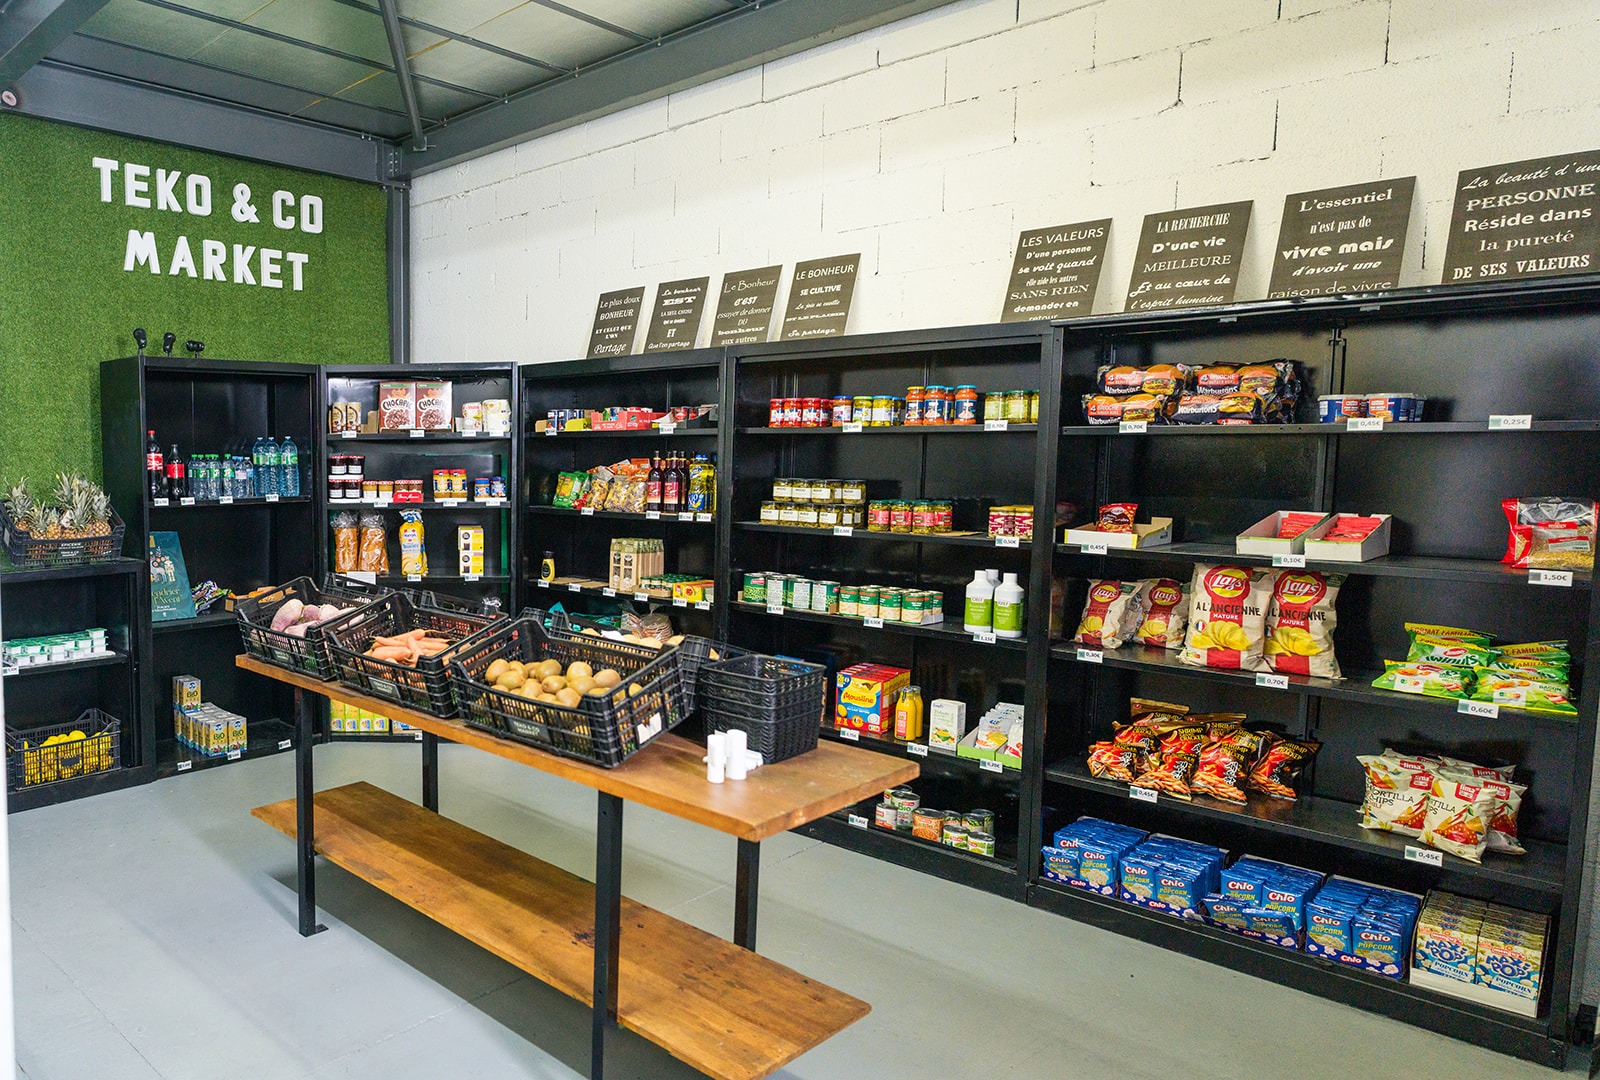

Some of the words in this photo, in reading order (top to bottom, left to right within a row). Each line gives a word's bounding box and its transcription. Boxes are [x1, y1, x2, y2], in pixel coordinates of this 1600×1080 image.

[1462, 177, 1488, 190] La
[1495, 167, 1551, 185] beauté
[93, 157, 212, 216] TEKO
[231, 183, 259, 222] &
[272, 190, 322, 233] CO
[1299, 188, 1393, 212] L'essentiel
[1466, 183, 1596, 211] PERSONNE
[1157, 222, 1169, 233] LA
[1171, 213, 1230, 231] RECHERCHE
[1310, 220, 1335, 234] n'est
[1337, 220, 1356, 233] pas
[1359, 216, 1372, 228] de
[1464, 213, 1534, 232] Réside
[1540, 208, 1592, 222] dans
[1022, 237, 1042, 247] LES
[1046, 228, 1103, 243] VALEURS
[1152, 241, 1199, 253] D'une
[1204, 236, 1226, 247] vie
[1479, 239, 1499, 251] la
[1505, 230, 1574, 251] pureté
[1052, 246, 1091, 257] personne
[1282, 245, 1332, 260] vivre
[1339, 236, 1394, 254] mais
[124, 229, 308, 290] MARKET
[1033, 263, 1054, 272] voit
[1057, 255, 1097, 273] quand
[1143, 255, 1231, 273] MEILLEURE
[796, 271, 806, 280] LE
[808, 264, 854, 278] BONHEUR
[1292, 263, 1349, 277] d'avoir
[1353, 261, 1382, 270] une
[1453, 267, 1472, 279] DE
[1480, 262, 1507, 277] SES
[1516, 255, 1590, 272] VALEURS
[724, 283, 736, 293] Le
[738, 278, 775, 291] Bonheur
[810, 285, 842, 294] CULTIVE
[1011, 289, 1048, 300] SANS
[1051, 284, 1089, 296] RIEN
[1129, 282, 1152, 297] Et
[1176, 279, 1210, 288] cœur
[1214, 274, 1230, 284] de
[1270, 286, 1320, 299] raison
[1326, 281, 1347, 293] de
[1352, 281, 1392, 291] vivre
[609, 298, 622, 308] plus
[1014, 302, 1064, 313] demander
[1131, 299, 1173, 311] l'esprit
[600, 309, 634, 320] BONHEUR
[740, 308, 749, 316] de
[667, 328, 676, 338] ET
[718, 326, 765, 335] bonheur
[594, 343, 626, 354] Partage
[1212, 574, 1243, 591] Lay's
[1284, 580, 1318, 597] Lay's
[1203, 603, 1261, 616] L'ANCIENNE
[1272, 608, 1327, 621] L'ANCIENNE
[1512, 646, 1548, 655] FAMILIAL
[843, 692, 873, 703] Mousline
[1470, 706, 1494, 715] 0,60€
[1138, 790, 1154, 798] 0,45€
[1083, 851, 1106, 860] Chio
[1418, 852, 1440, 861] 0,45€
[1125, 866, 1148, 875] Chio
[1160, 879, 1185, 888] Chio
[1228, 881, 1254, 891] Chio
[1268, 892, 1295, 903] Chio
[1265, 904, 1296, 913] POPCORN
[1312, 915, 1341, 926] Chio
[1359, 932, 1392, 942] Chio
[1340, 955, 1362, 963] Chio
[1430, 947, 1466, 961] POP
[1434, 961, 1468, 977] POPCORN
[1491, 962, 1525, 977] POP
[1495, 977, 1532, 994] POPCORN
